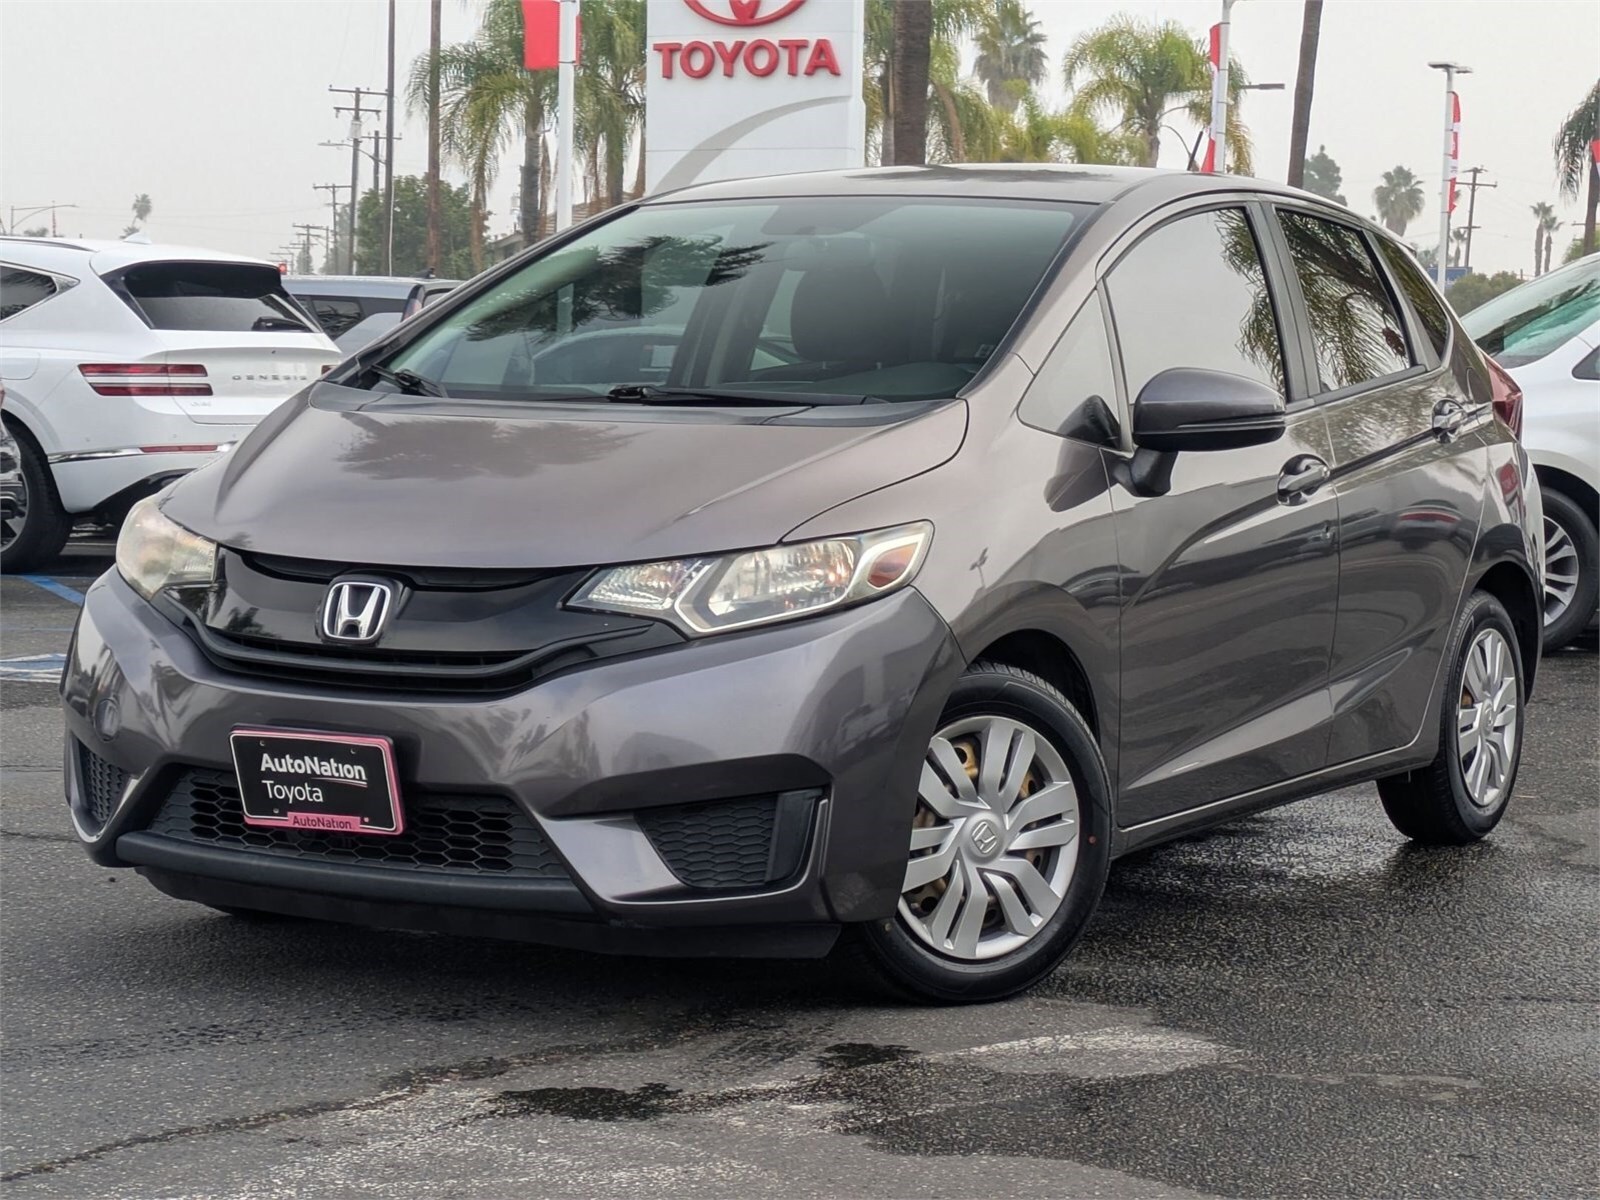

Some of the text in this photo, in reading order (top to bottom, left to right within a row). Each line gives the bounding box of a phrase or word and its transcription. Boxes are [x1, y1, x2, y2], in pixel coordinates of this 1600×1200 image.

[653, 38, 841, 79] TOYOTA
[260, 753, 367, 780] AutoNation
[261, 780, 324, 804] Toyota
[292, 815, 351, 829] AutoNation
